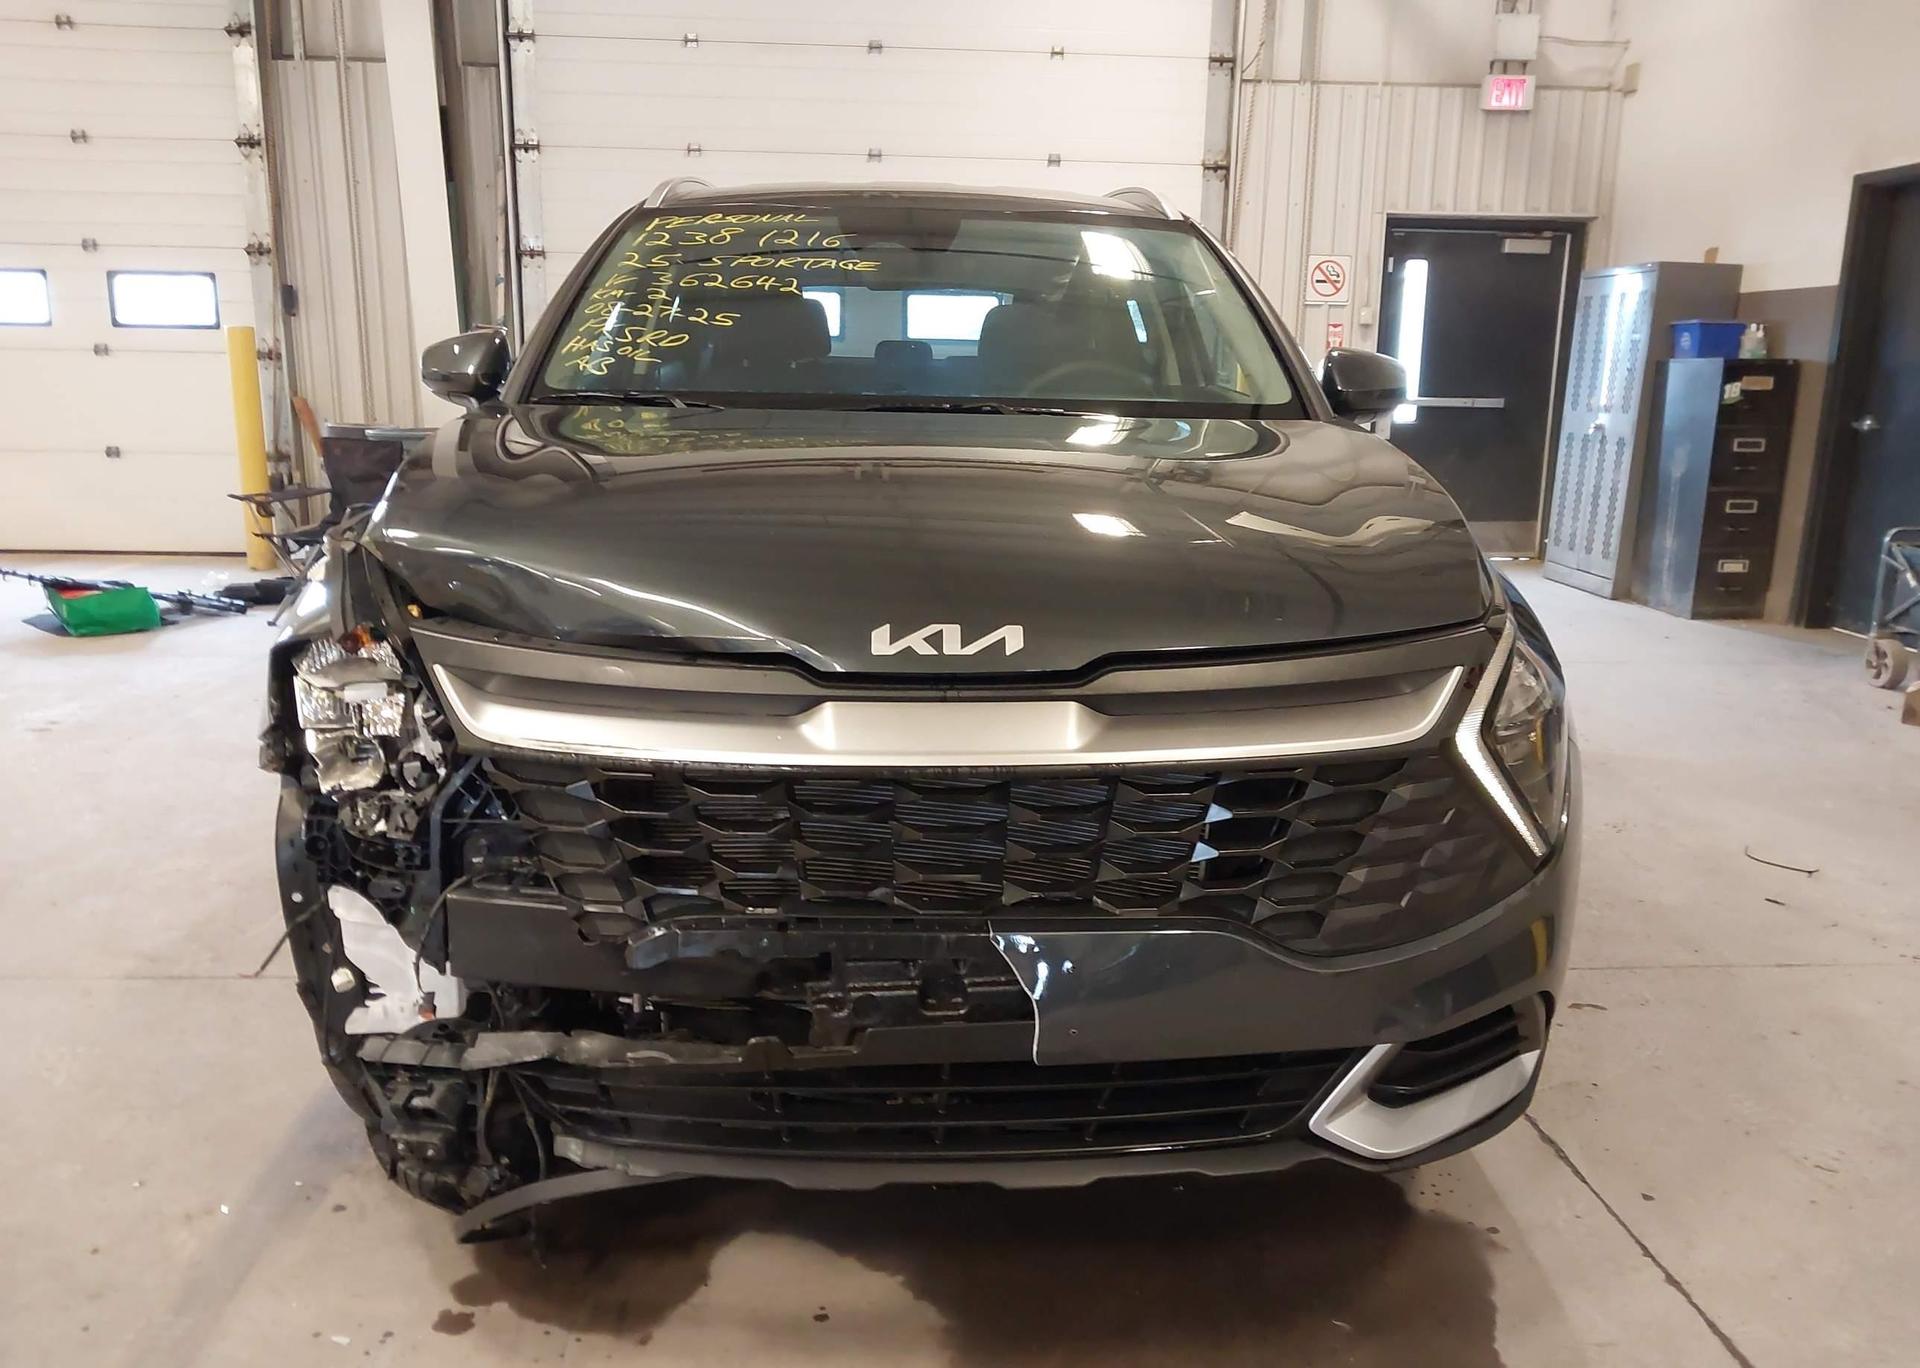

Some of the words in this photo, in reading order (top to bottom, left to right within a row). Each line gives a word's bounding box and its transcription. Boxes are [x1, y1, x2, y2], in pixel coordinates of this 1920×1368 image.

[1491, 78, 1526, 107] EXIT
[645, 213, 820, 231] PERSONAL
[617, 252, 683, 269] 25
[698, 255, 882, 271] SPORTAGE
[652, 271, 802, 296] 362642
